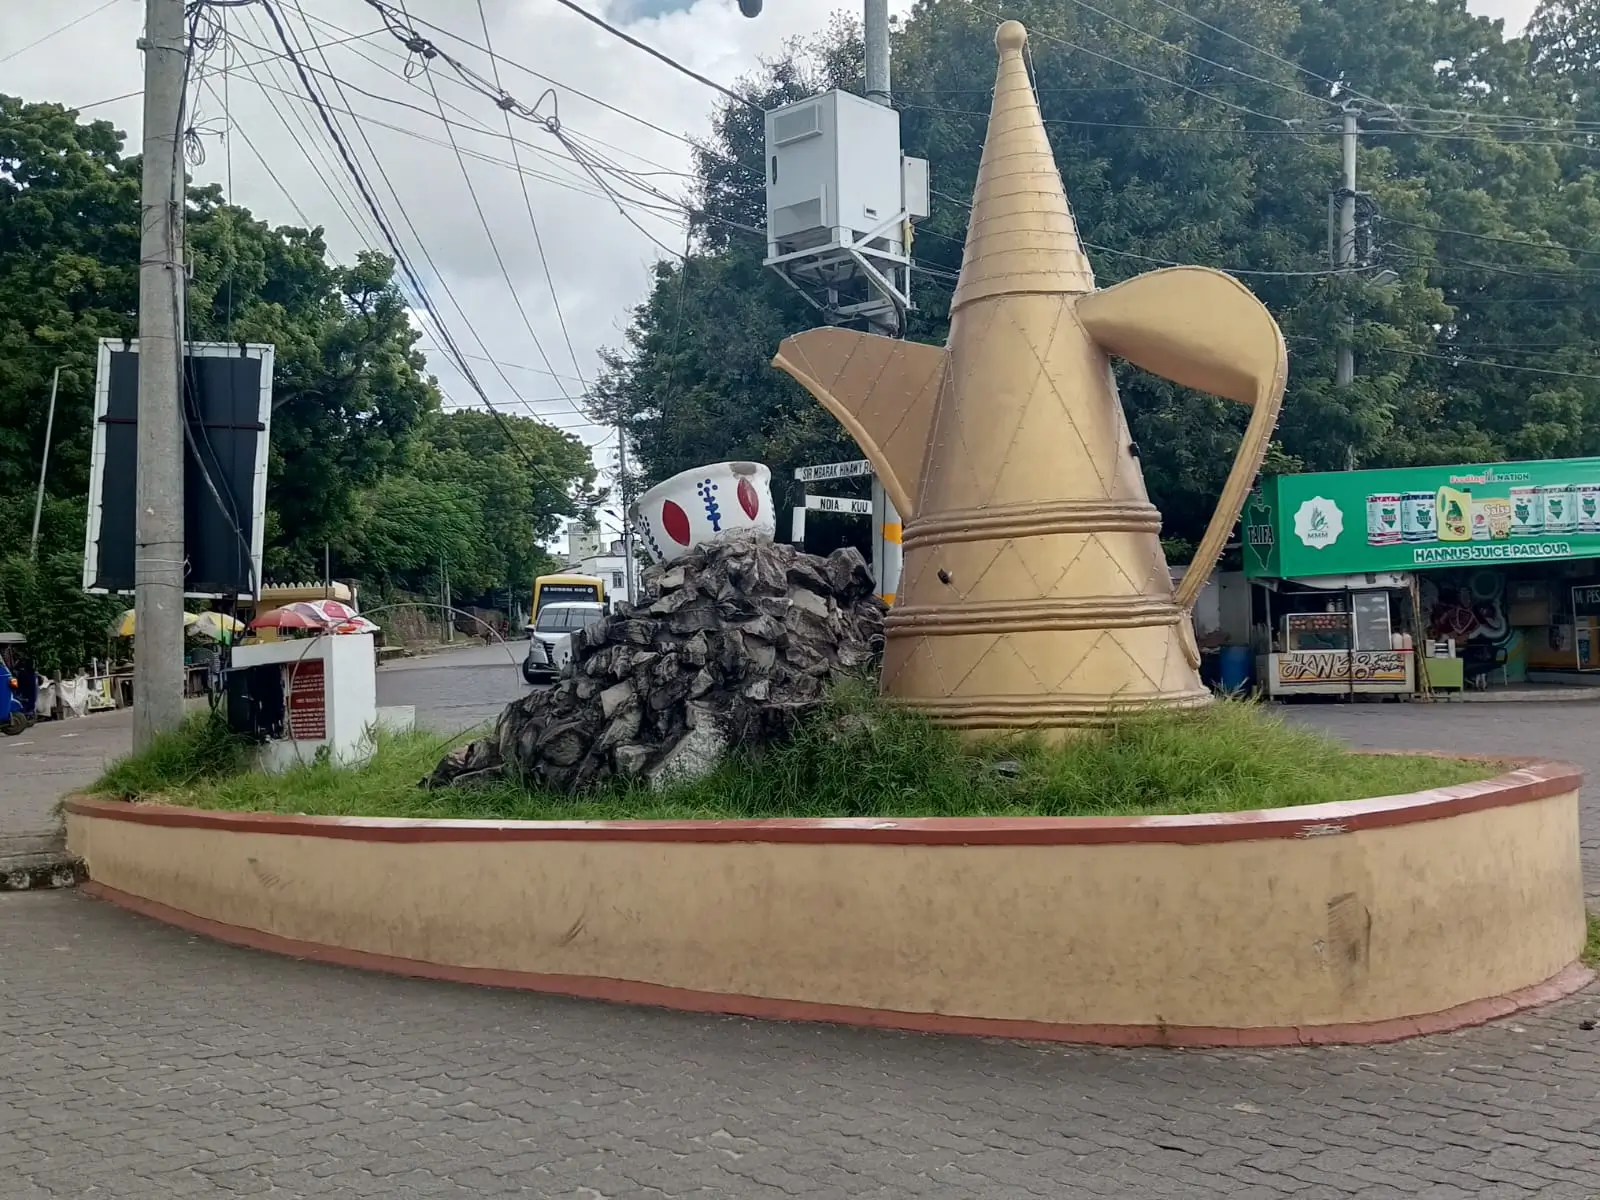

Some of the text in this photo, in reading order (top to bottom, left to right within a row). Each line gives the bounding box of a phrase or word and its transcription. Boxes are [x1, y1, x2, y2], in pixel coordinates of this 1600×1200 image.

[802, 468, 813, 480] SIR
[1497, 473, 1529, 481] NATION
[820, 499, 868, 512] NDIA KUU
[1484, 503, 1510, 515] Salsa
[1247, 525, 1274, 544] TAIFA
[1415, 543, 1569, 562] HANNUS JUICE PARLOUR
